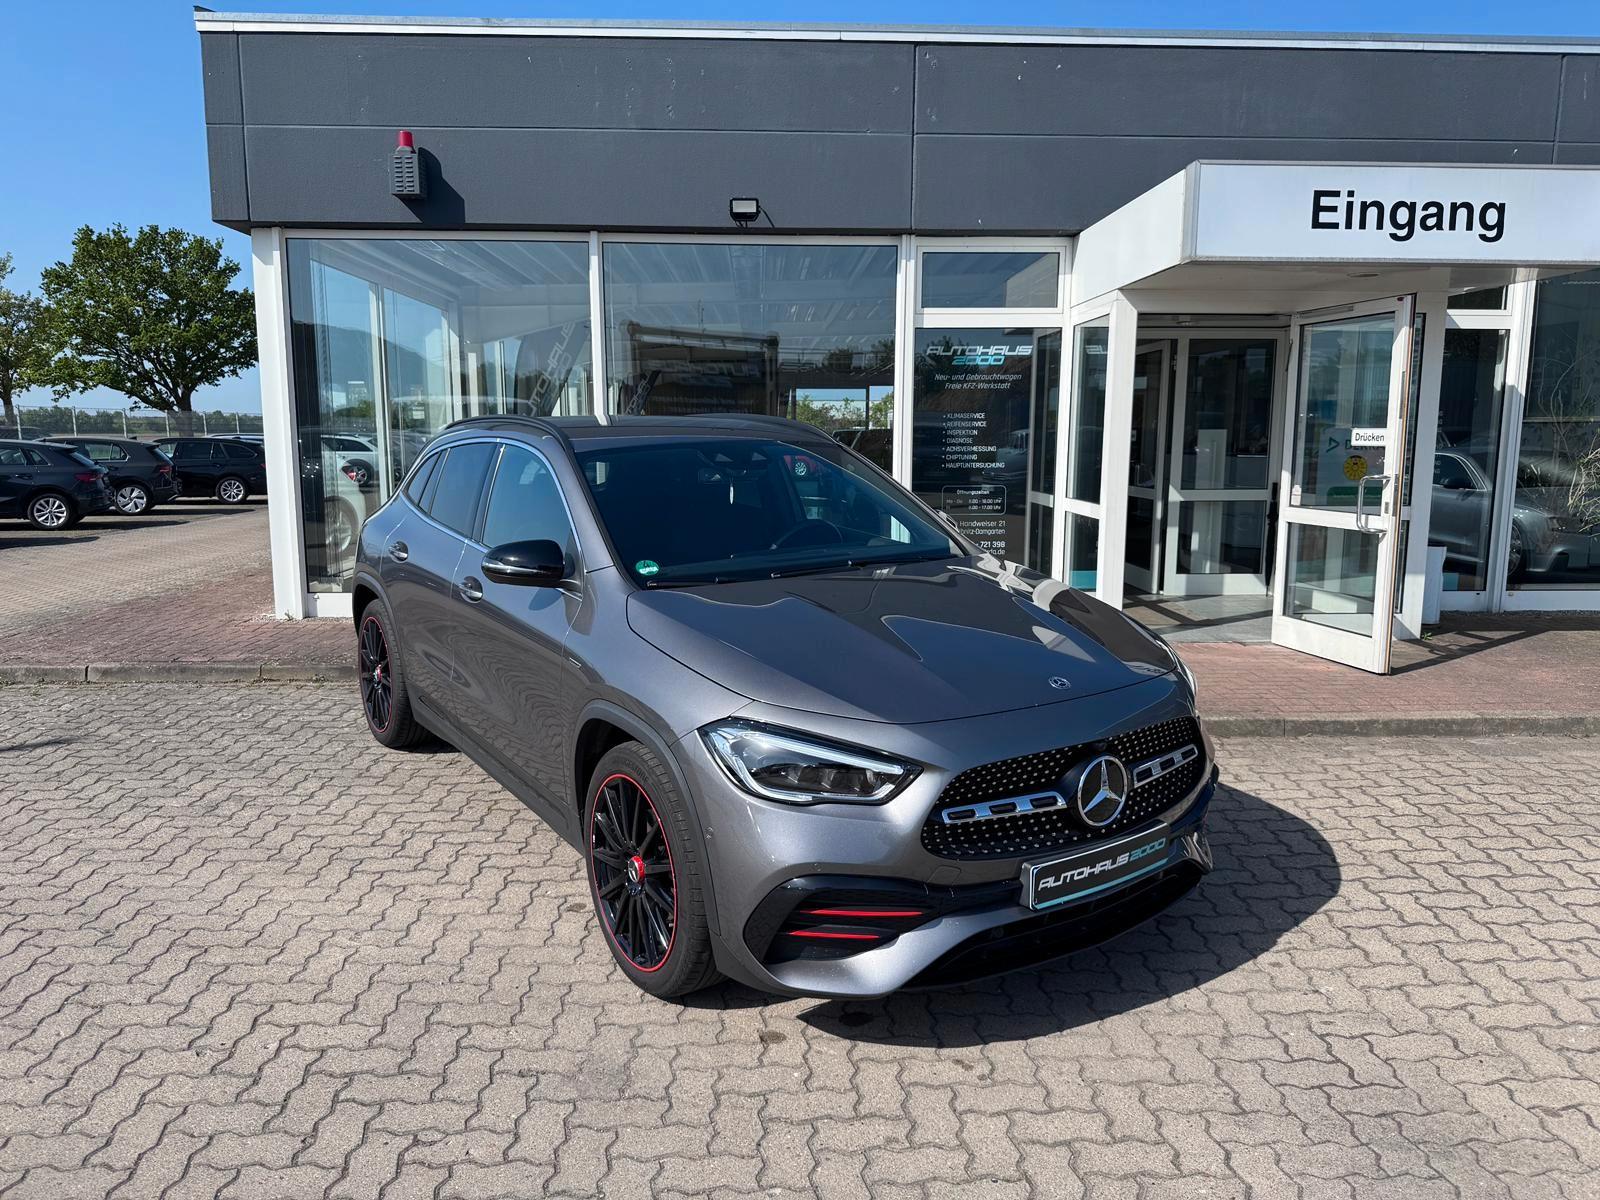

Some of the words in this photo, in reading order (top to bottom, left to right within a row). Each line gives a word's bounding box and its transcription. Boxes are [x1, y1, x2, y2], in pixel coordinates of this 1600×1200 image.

[1311, 189, 1506, 243] Eingang
[926, 345, 1034, 356] AUTOHAUS
[952, 355, 1005, 366] 2000
[966, 373, 1022, 382] Gebrauchtwagen
[1354, 432, 1385, 442] Drücken
[960, 528, 1006, 536] bnitz-Damgarten
[1038, 852, 1130, 891] AUTOHAUS
[1129, 837, 1167, 862] 2000
